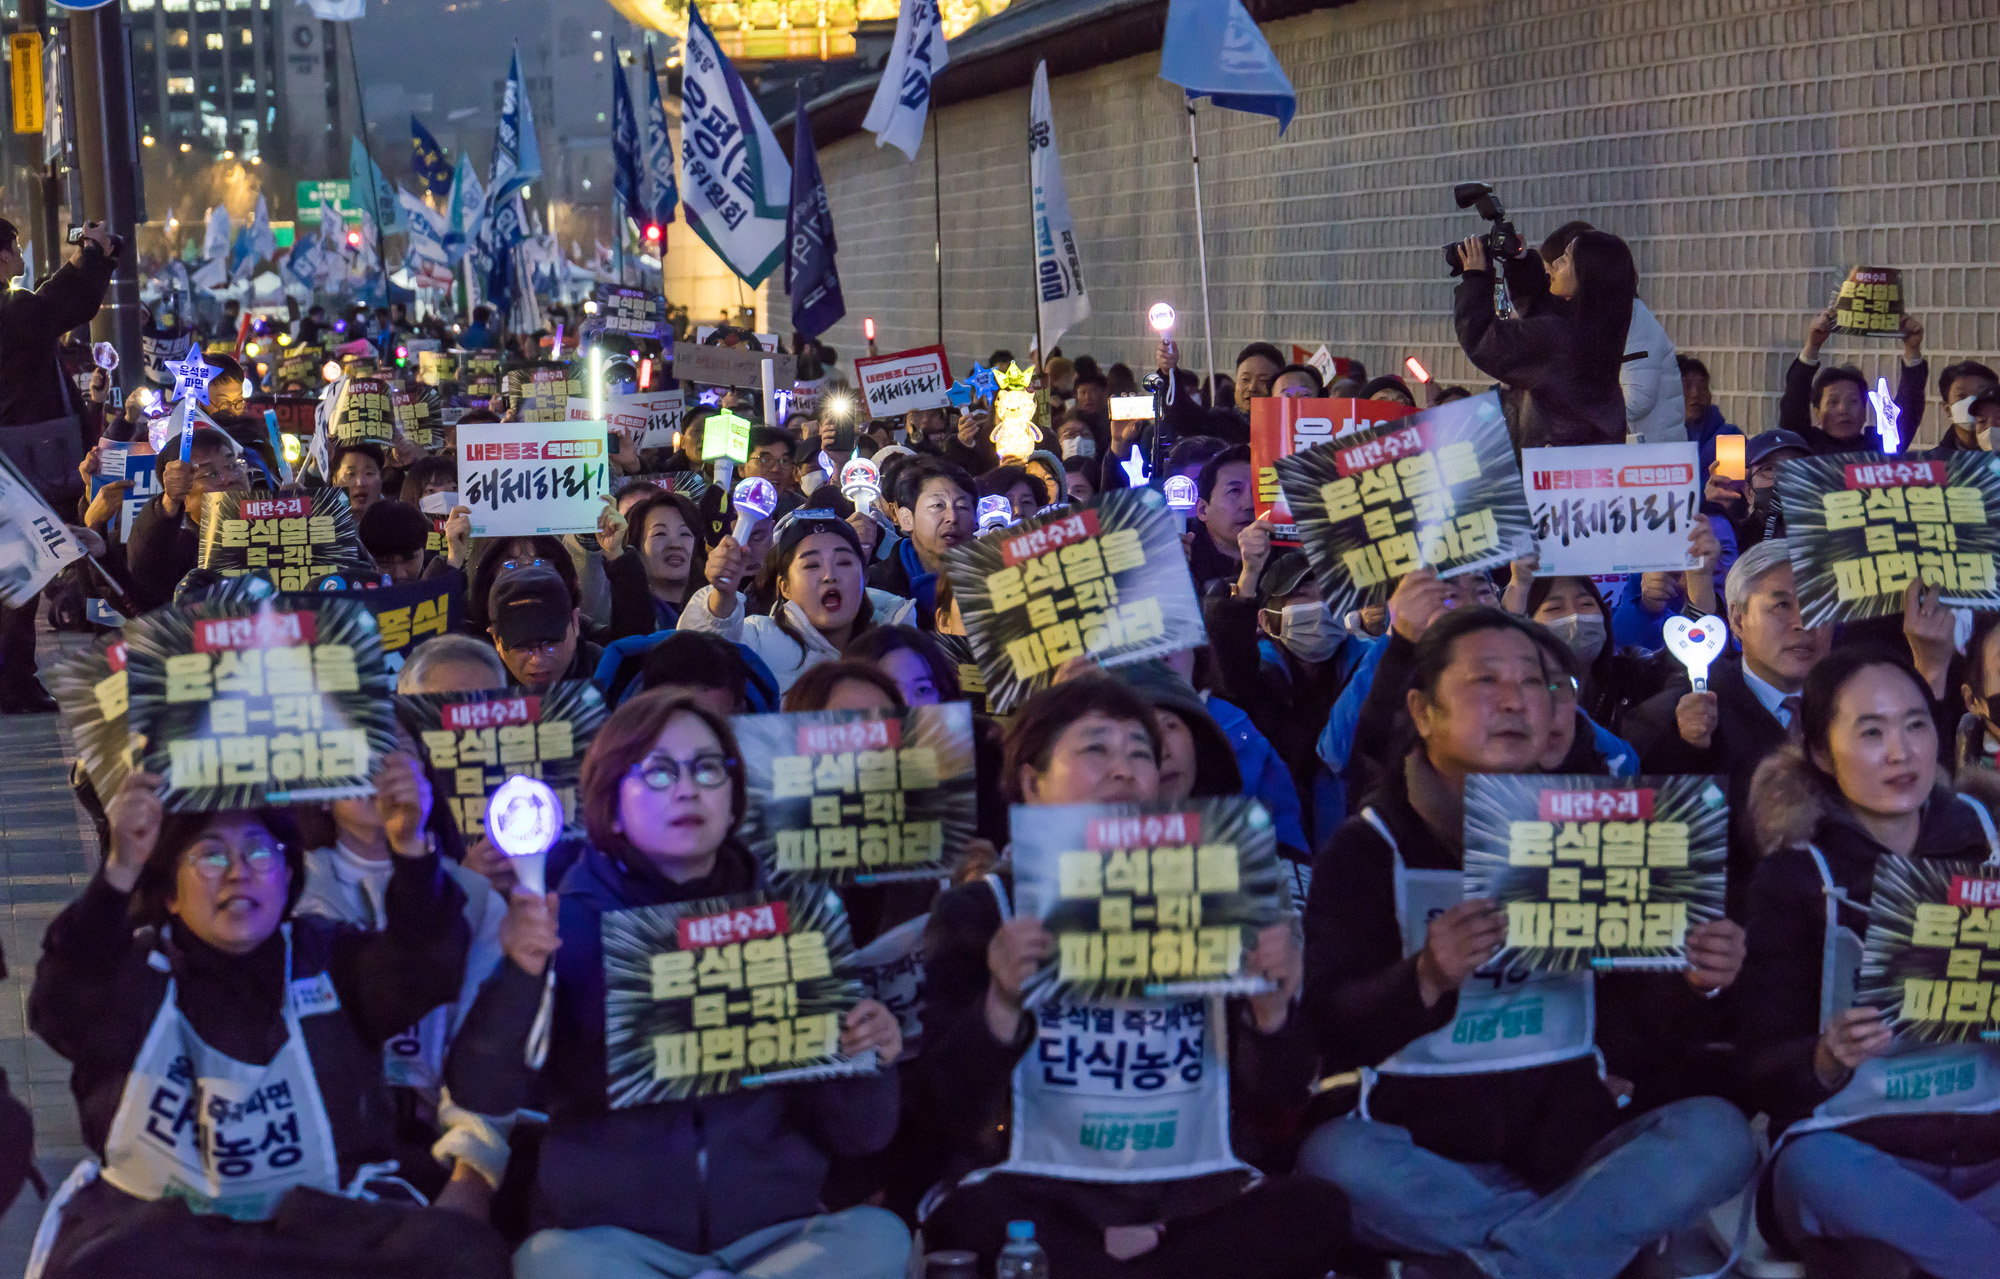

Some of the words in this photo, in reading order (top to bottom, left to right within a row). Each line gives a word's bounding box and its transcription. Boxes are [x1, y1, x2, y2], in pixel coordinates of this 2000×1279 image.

[1840, 281, 1899, 301] 윤석열을
[180, 365, 209, 378] 윤석열
[184, 378, 203, 389] 파면
[521, 380, 582, 398] 윤석열을
[870, 374, 940, 404] 해체하라!
[466, 442, 539, 461] 내란동조
[548, 441, 599, 458] 국민의힘
[1344, 428, 1422, 471] 내란수괴
[466, 462, 604, 511] 해체하라!
[1320, 440, 1481, 524] 윤석열을
[1533, 468, 1615, 490] 내란동조
[1855, 463, 1934, 485] 내란수괴
[246, 498, 302, 517] 내란수괴
[1532, 490, 1696, 547] 해체하라!
[1823, 486, 1987, 531] 윤석열을
[222, 515, 336, 547] 윤석열을
[1010, 514, 1087, 558] 내란수괴
[1343, 508, 1499, 588] 파면하라
[1864, 523, 1957, 553] 즉-각!
[247, 545, 312, 567] 즉-각!
[986, 528, 1147, 614] 윤석열을
[1833, 551, 1996, 601] 파면하라
[1026, 577, 1118, 628] 즉-각!
[1006, 597, 1165, 680] 파면하라
[166, 643, 360, 702] 윤석열을
[452, 698, 528, 726] 내란수괴
[168, 729, 369, 787] 파면하라
[422, 720, 574, 769] 윤석열을
[807, 726, 889, 750] 내란수괴
[773, 748, 940, 800] 윤석열을
[1551, 791, 1639, 818] 내란수괴
[776, 821, 943, 872] 파면하라
[1099, 813, 1187, 845] 내란수괴
[1509, 820, 1689, 868] 윤석열을
[1059, 844, 1239, 897] 윤석열을
[1548, 867, 1649, 902] 즉-각!
[688, 907, 777, 946] 내란수괴
[1506, 901, 1688, 948] 파면하라
[651, 931, 832, 999] 윤석열을
[1059, 925, 1242, 980] 파면하라
[692, 982, 798, 1027] 즉-각!
[1901, 978, 2000, 1022] 파면
[653, 1013, 841, 1080] 파면하라
[1039, 1035, 1203, 1090] 단식농성
